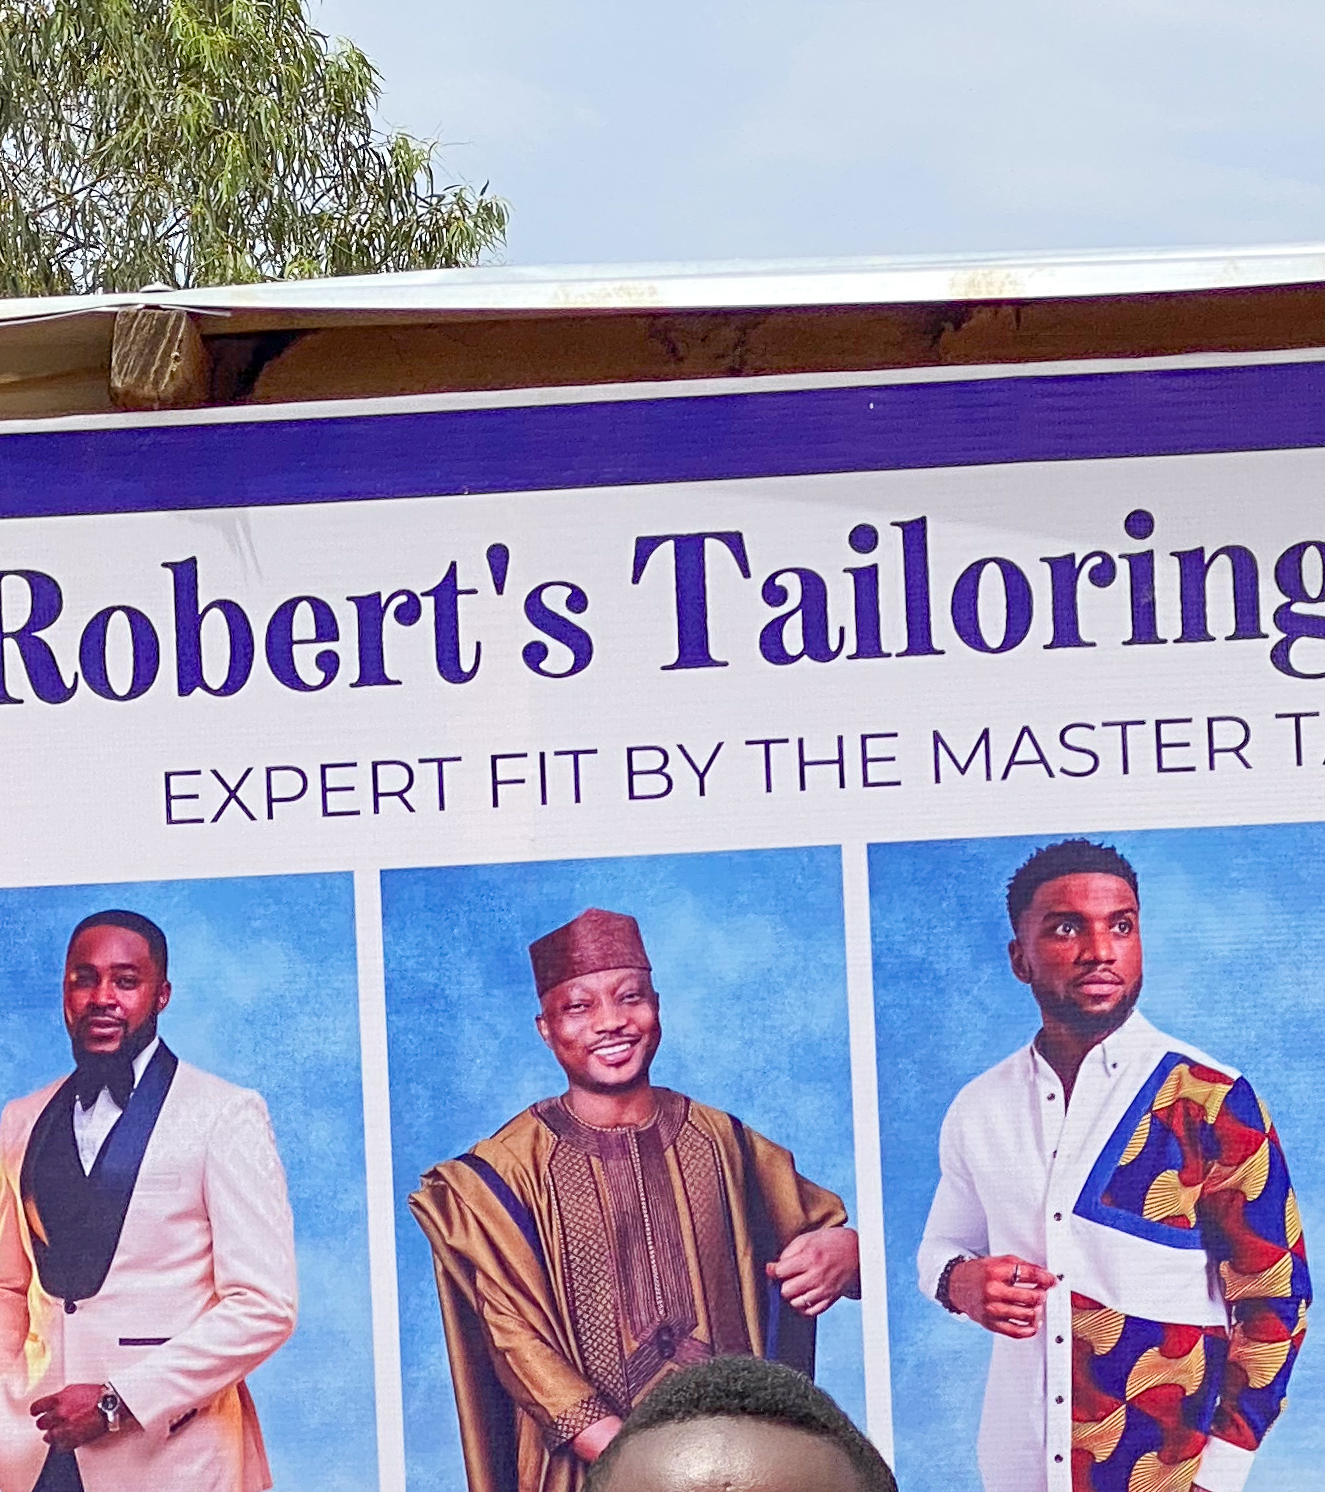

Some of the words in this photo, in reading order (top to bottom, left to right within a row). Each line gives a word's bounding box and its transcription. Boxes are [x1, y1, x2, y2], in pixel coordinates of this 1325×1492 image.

[164, 756, 462, 825] EXPERT
[490, 748, 598, 808] FIT
[626, 741, 725, 801] BY
[744, 732, 902, 793] THE
[932, 716, 1253, 784] MASTER
